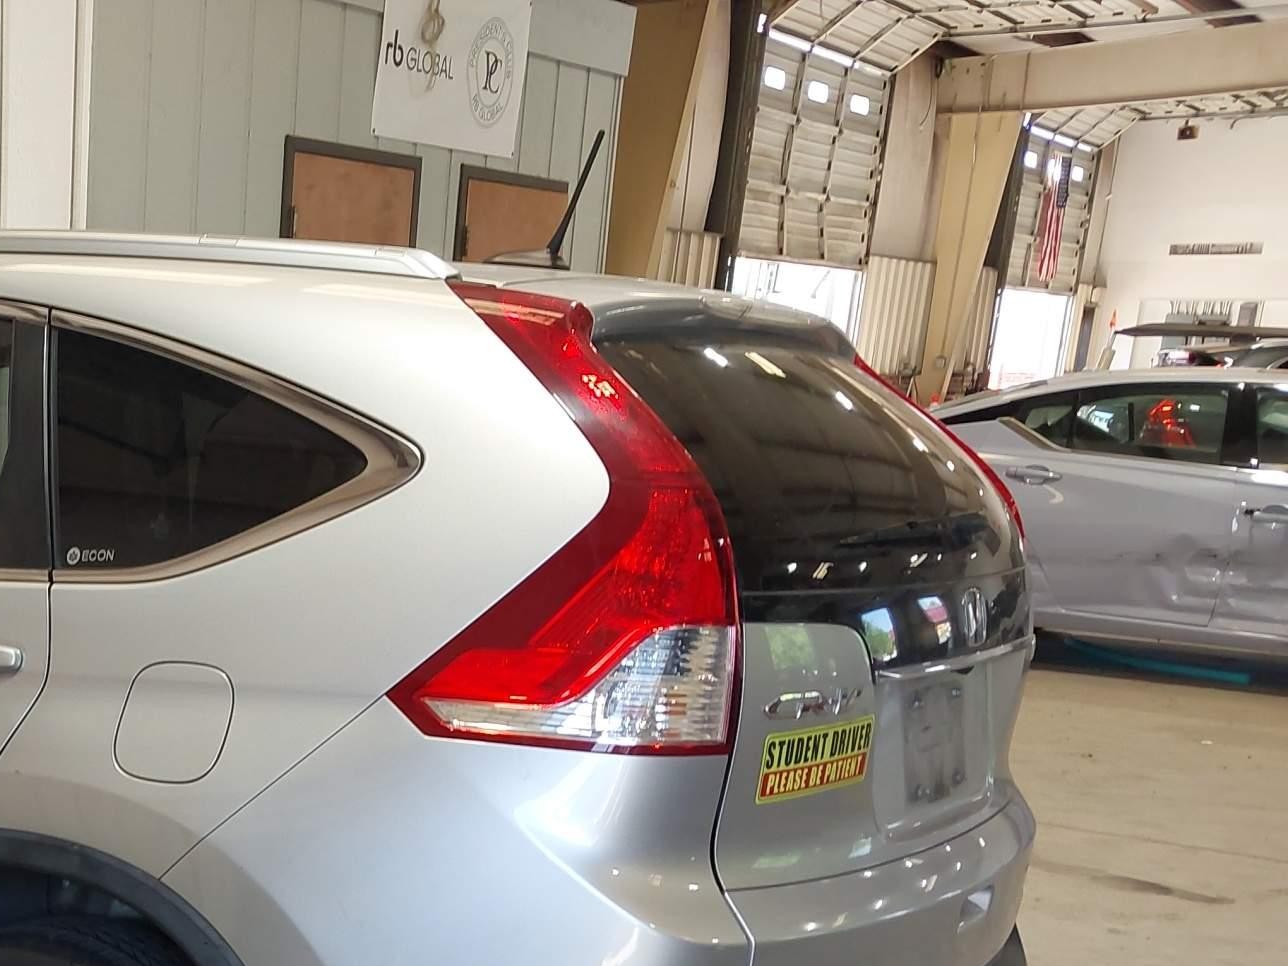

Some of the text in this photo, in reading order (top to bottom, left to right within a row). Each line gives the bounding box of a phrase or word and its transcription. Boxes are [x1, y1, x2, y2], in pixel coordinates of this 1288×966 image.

[385, 29, 454, 80] rb GLOBAL
[81, 548, 115, 562] ECON
[765, 722, 872, 770] STUDENT DRIVER
[765, 754, 863, 796] PLEASE BE PATIENT
